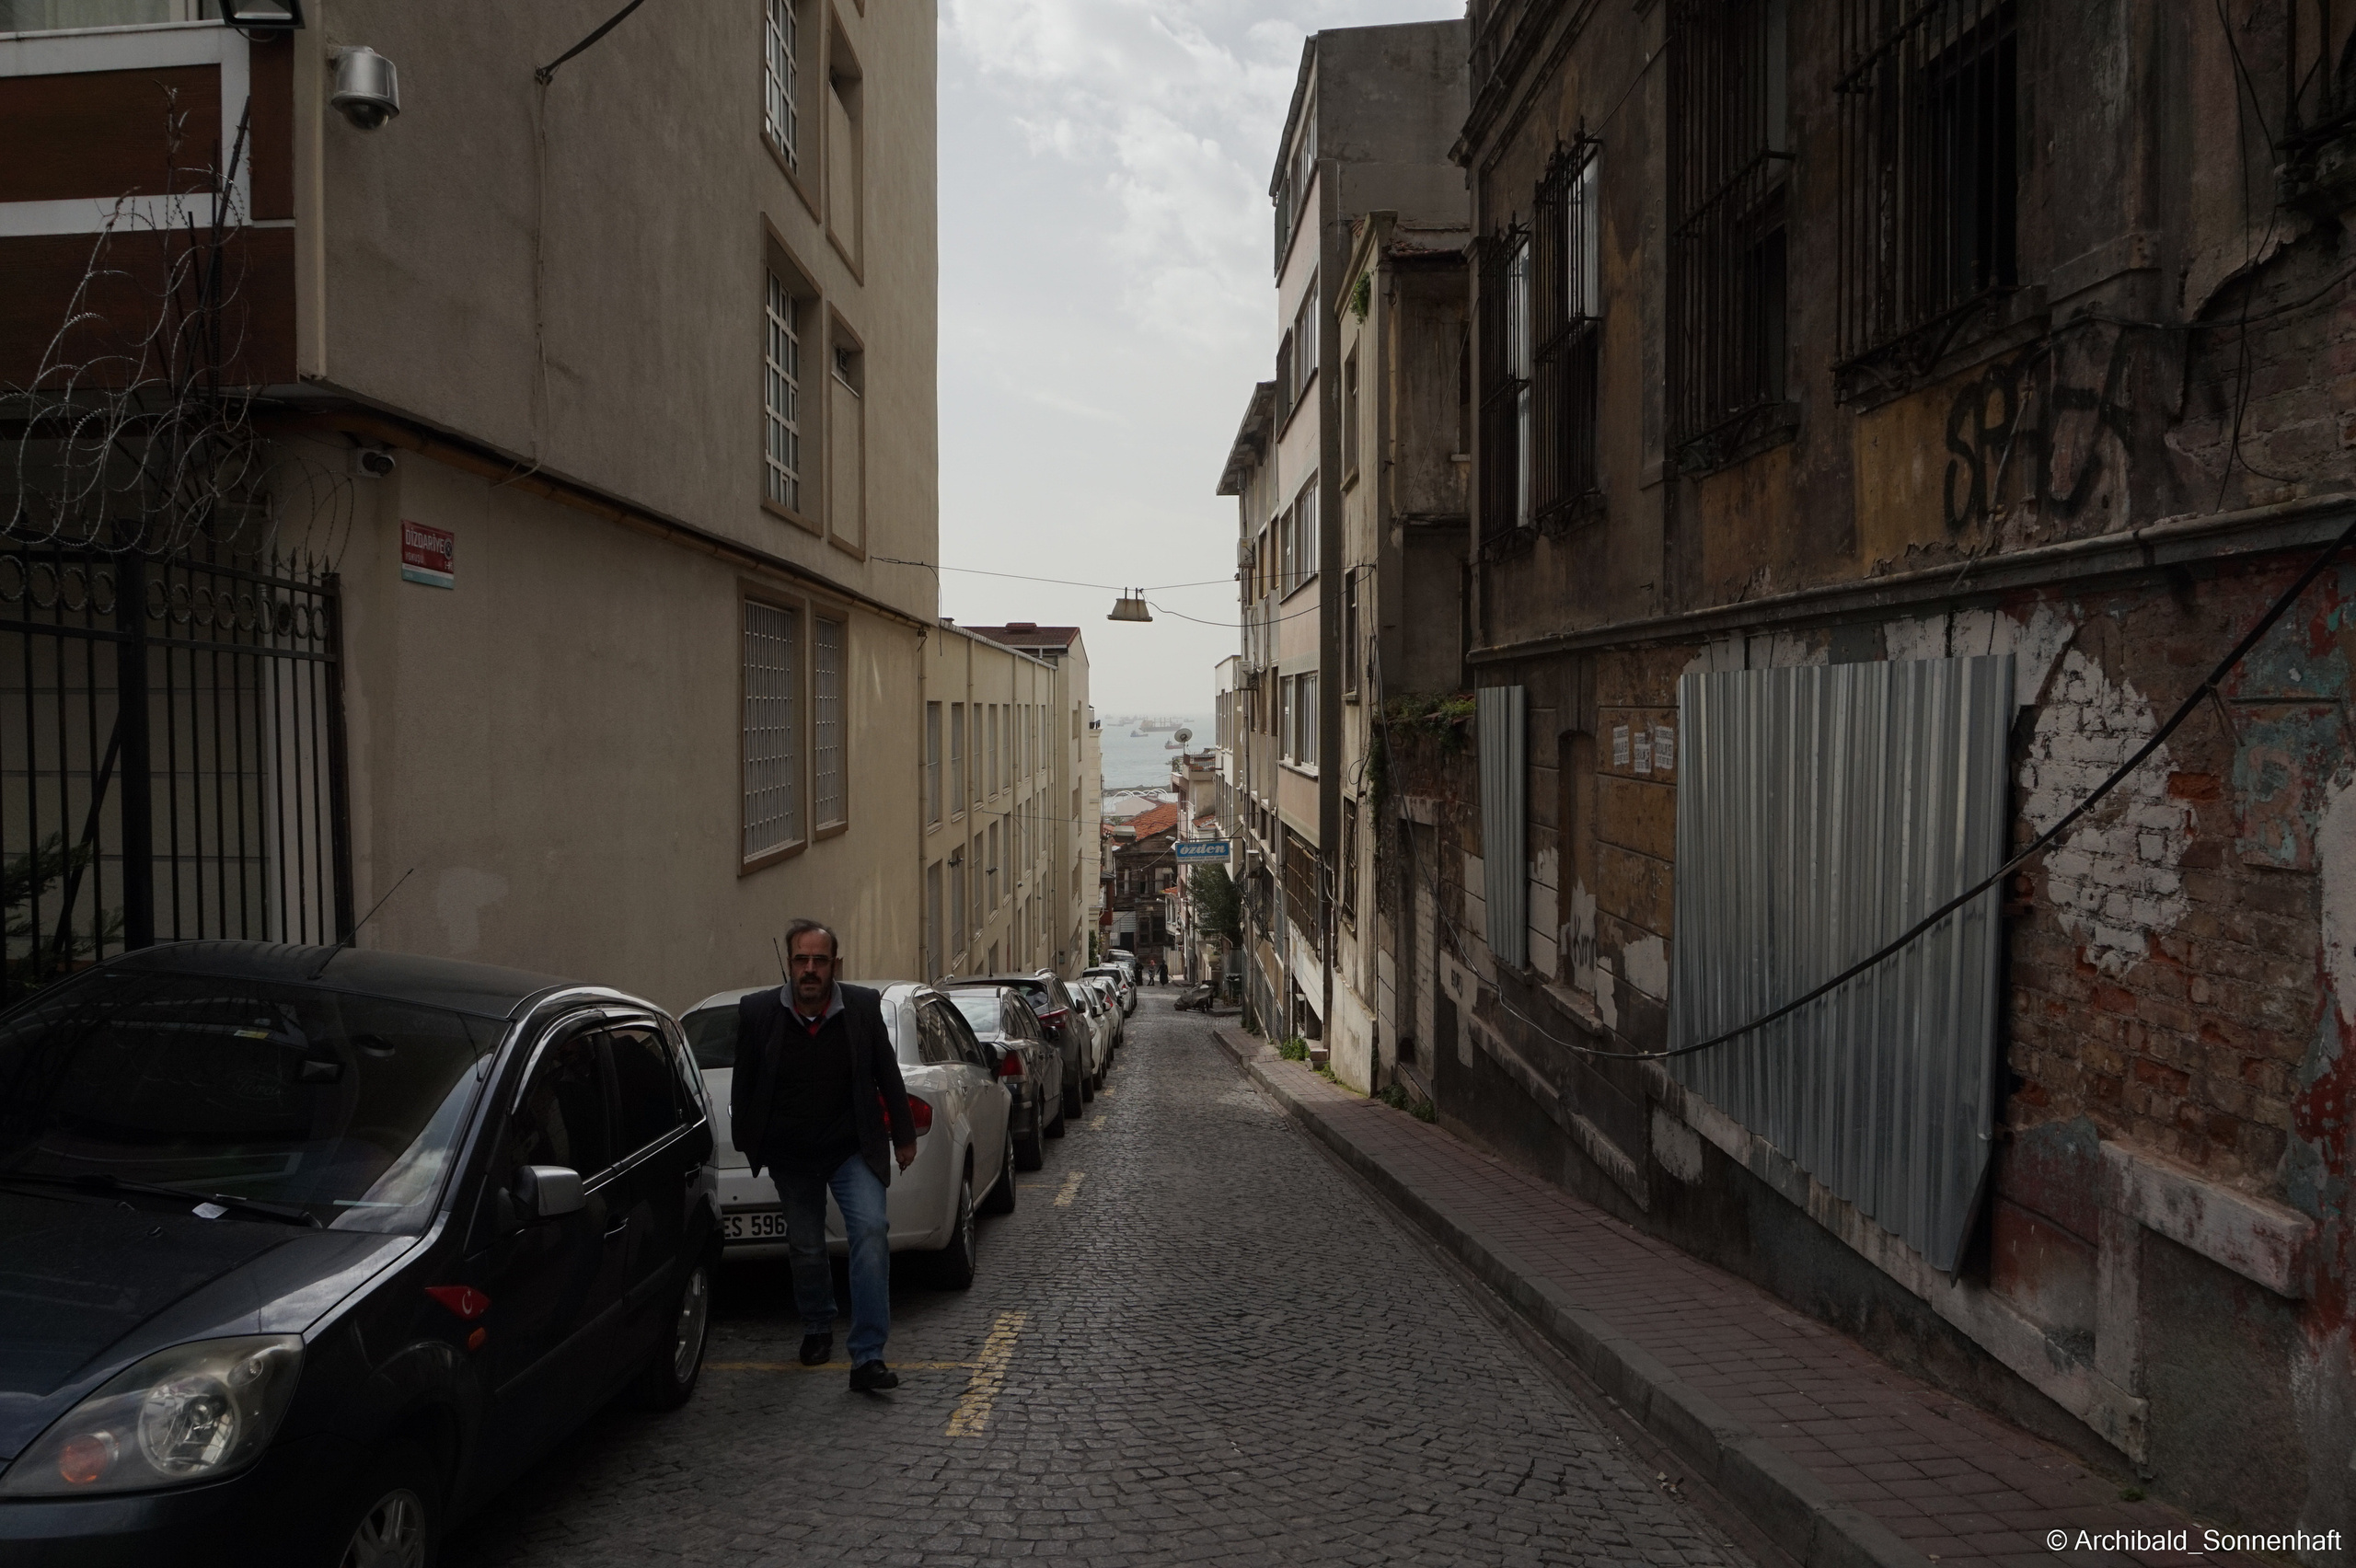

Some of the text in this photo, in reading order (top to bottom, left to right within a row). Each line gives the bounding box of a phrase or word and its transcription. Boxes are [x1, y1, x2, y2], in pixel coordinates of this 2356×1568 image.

[405, 527, 445, 554] DİZDARİYE
[1180, 844, 1226, 855] özden
[751, 1215, 785, 1236] 596
